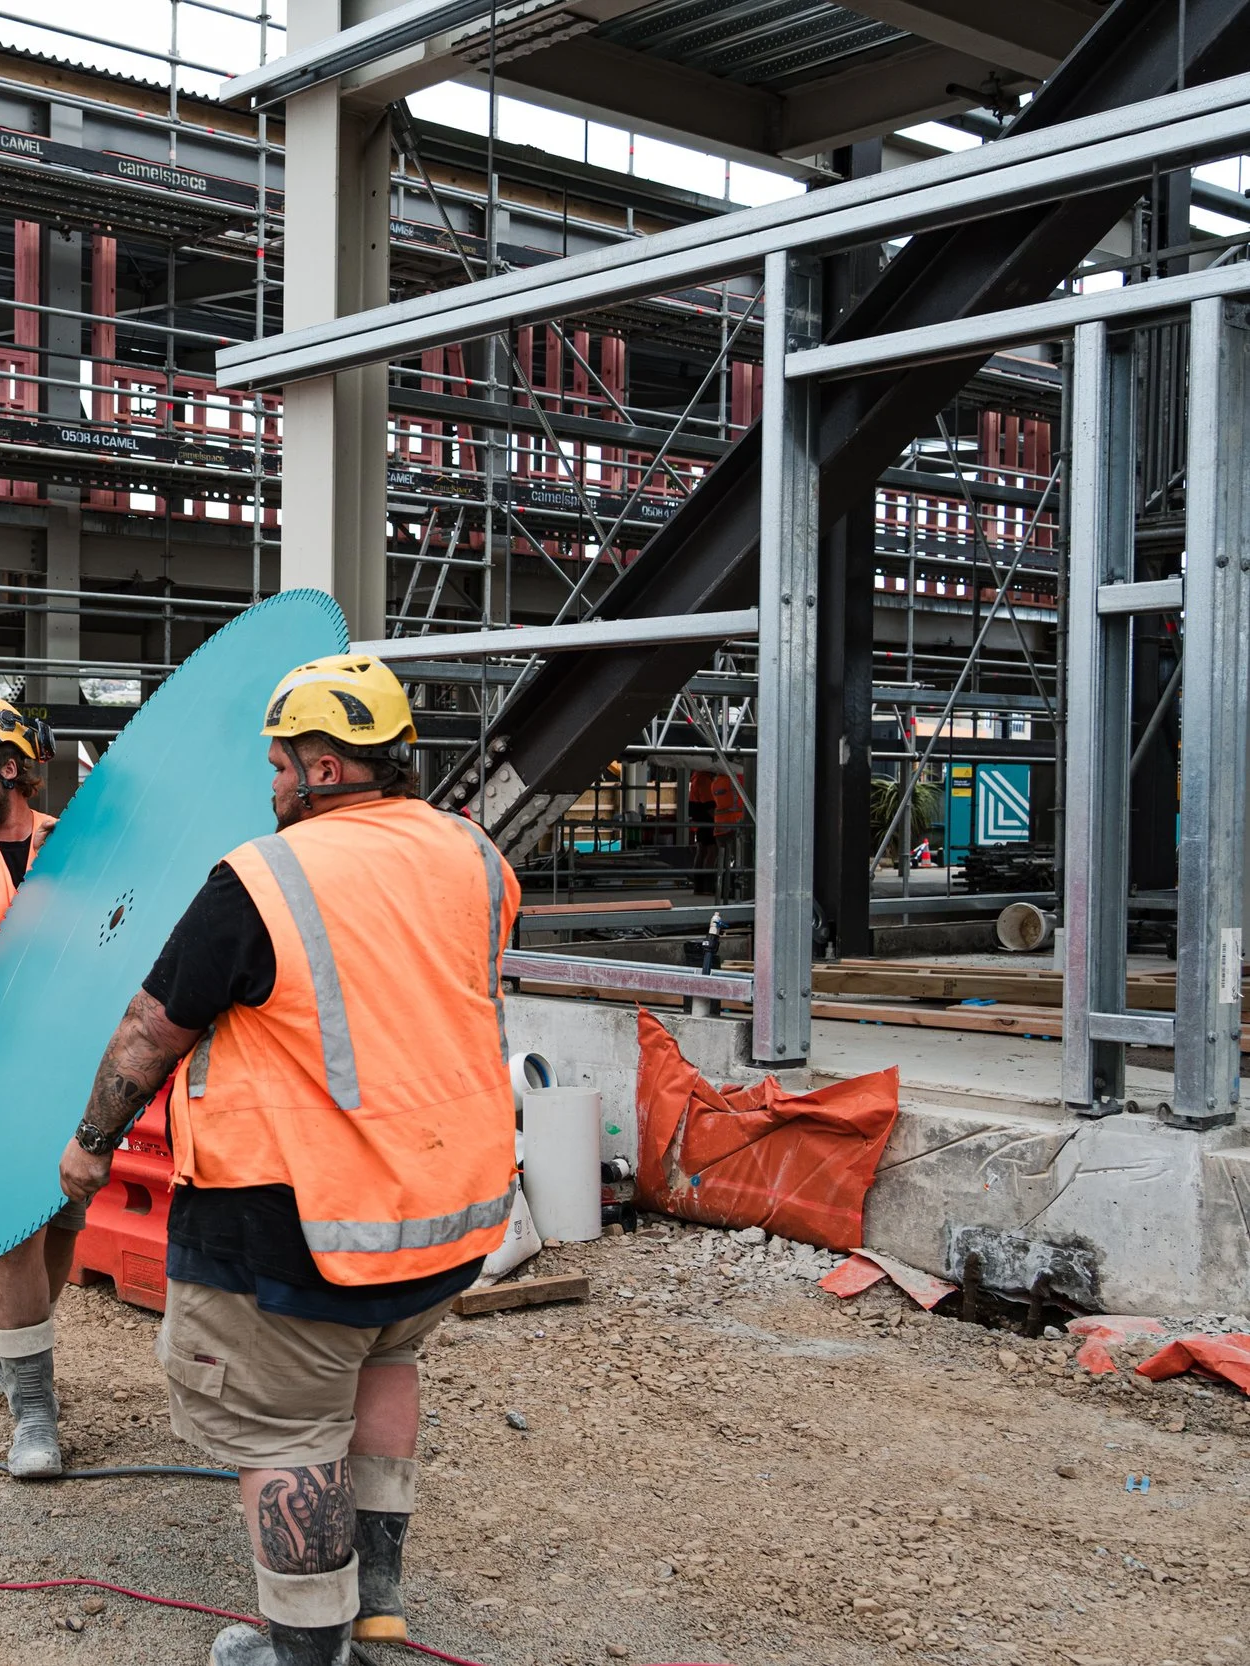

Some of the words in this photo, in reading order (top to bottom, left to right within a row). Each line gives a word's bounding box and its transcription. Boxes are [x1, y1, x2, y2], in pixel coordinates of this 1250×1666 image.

[1, 134, 44, 155] CAMEL
[118, 160, 207, 191] camelspace
[61, 429, 92, 445] 0508
[92, 434, 100, 446] 4
[102, 435, 140, 450] CAMEL
[177, 450, 225, 464] camelspace
